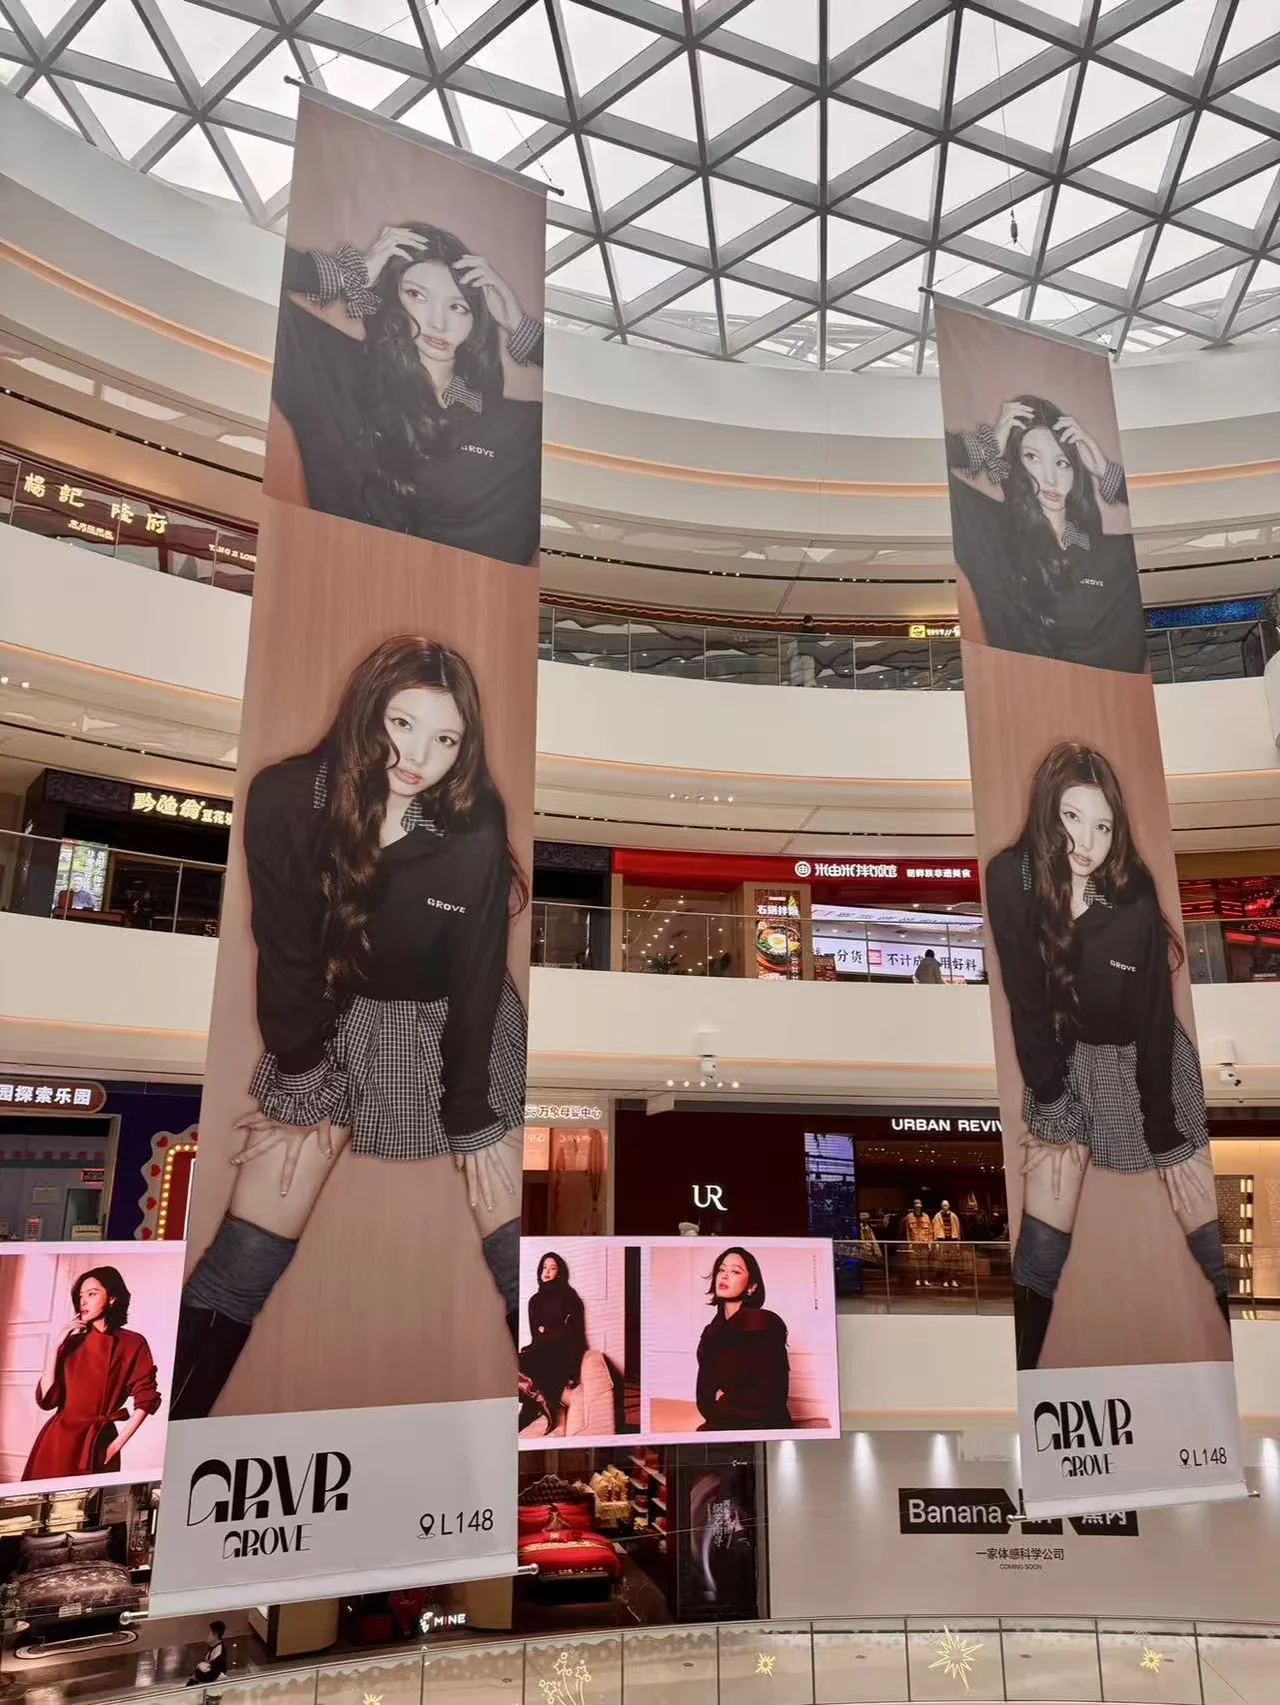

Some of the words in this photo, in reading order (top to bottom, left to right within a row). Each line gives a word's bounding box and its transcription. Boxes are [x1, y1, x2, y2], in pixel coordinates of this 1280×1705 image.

[427, 897, 467, 914] GROVE
[1109, 959, 1137, 973] GROVE
[891, 1118, 951, 1132] URBAN
[692, 1185, 728, 1211] UR
[1061, 1453, 1116, 1478] GROVE
[1193, 1446, 1228, 1467] L148
[908, 1498, 1003, 1525] Banana
[440, 1508, 494, 1536] L148
[222, 1522, 312, 1560] GROVE
[975, 1547, 1065, 1561] 一家体感科学公司
[999, 1563, 1024, 1571] COMING
[1024, 1563, 1043, 1571] SOON
[433, 1613, 467, 1627] MINE
